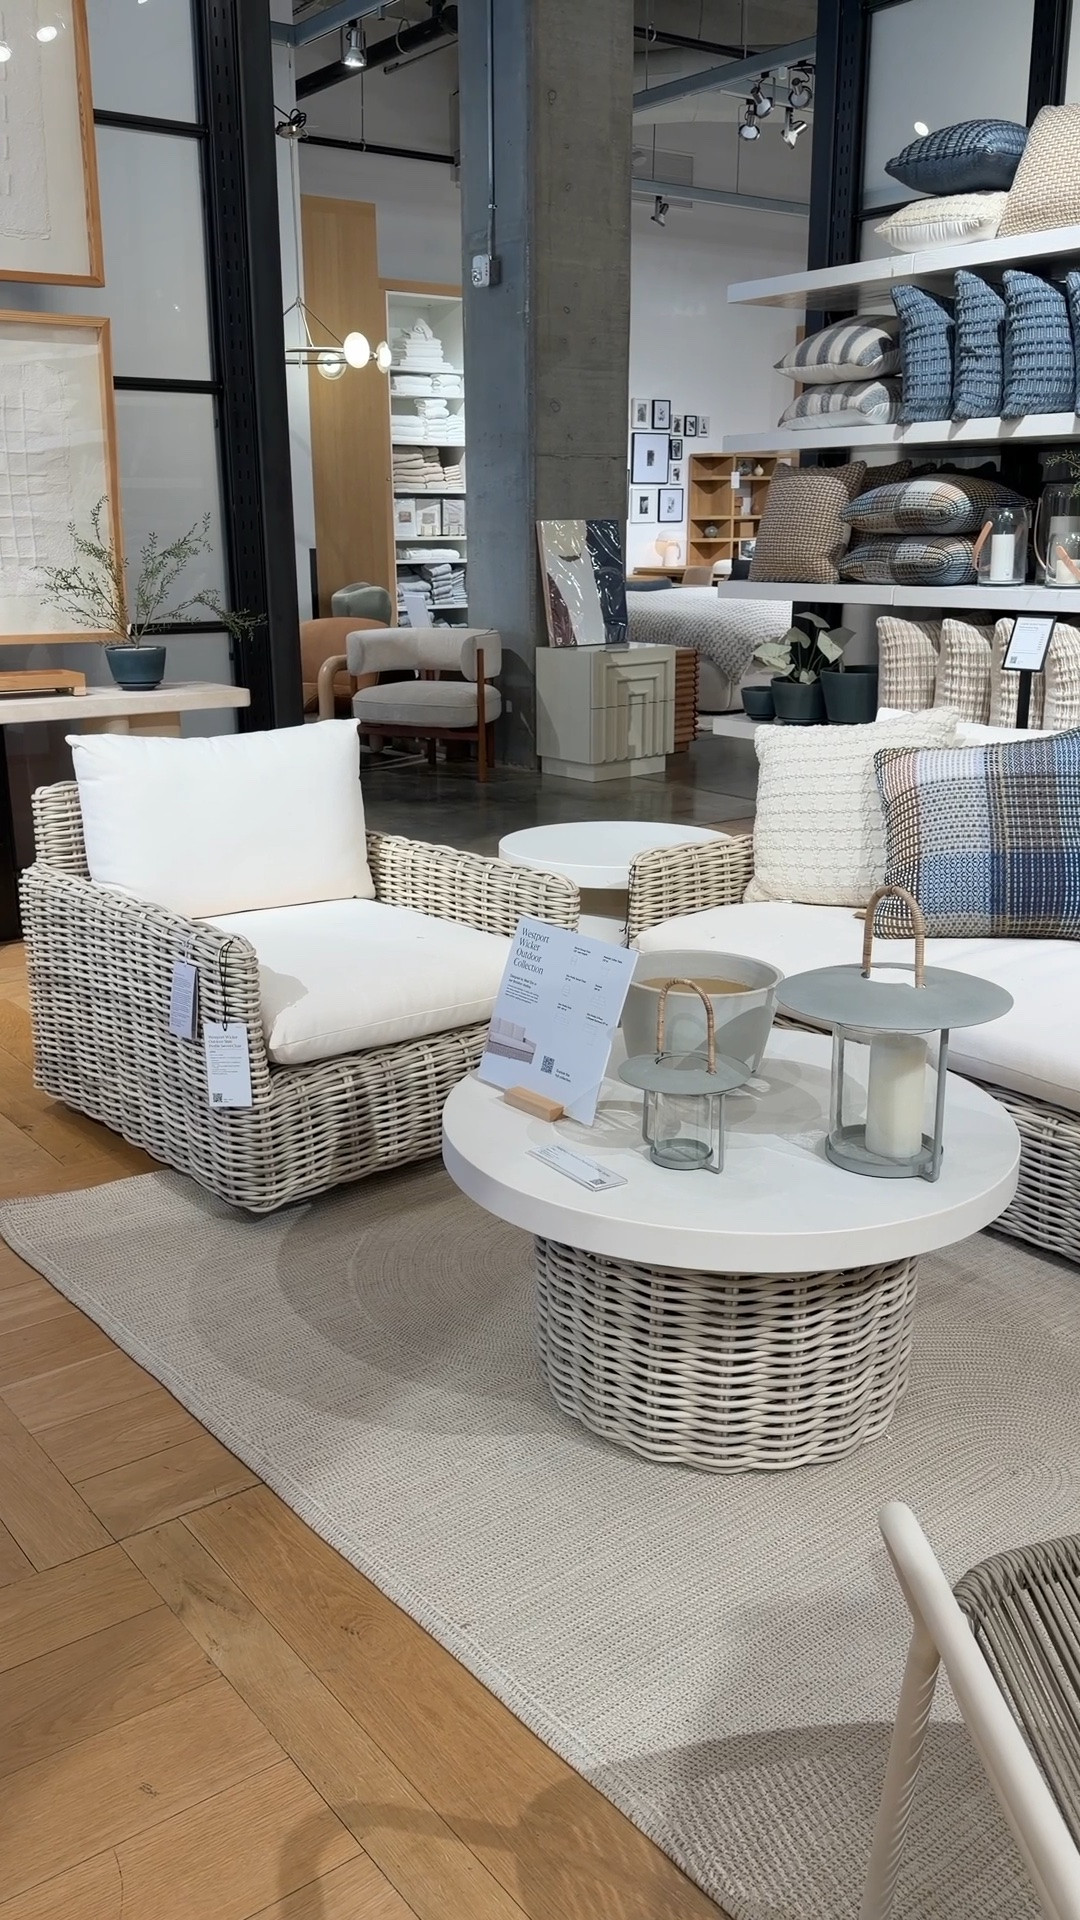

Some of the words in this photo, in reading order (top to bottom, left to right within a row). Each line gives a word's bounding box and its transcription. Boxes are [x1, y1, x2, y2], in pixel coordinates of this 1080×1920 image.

[522, 927, 550, 943] Westport
[519, 937, 541, 951] Wicker
[516, 947, 542, 963] Outdoor
[513, 957, 544, 975] Collection
